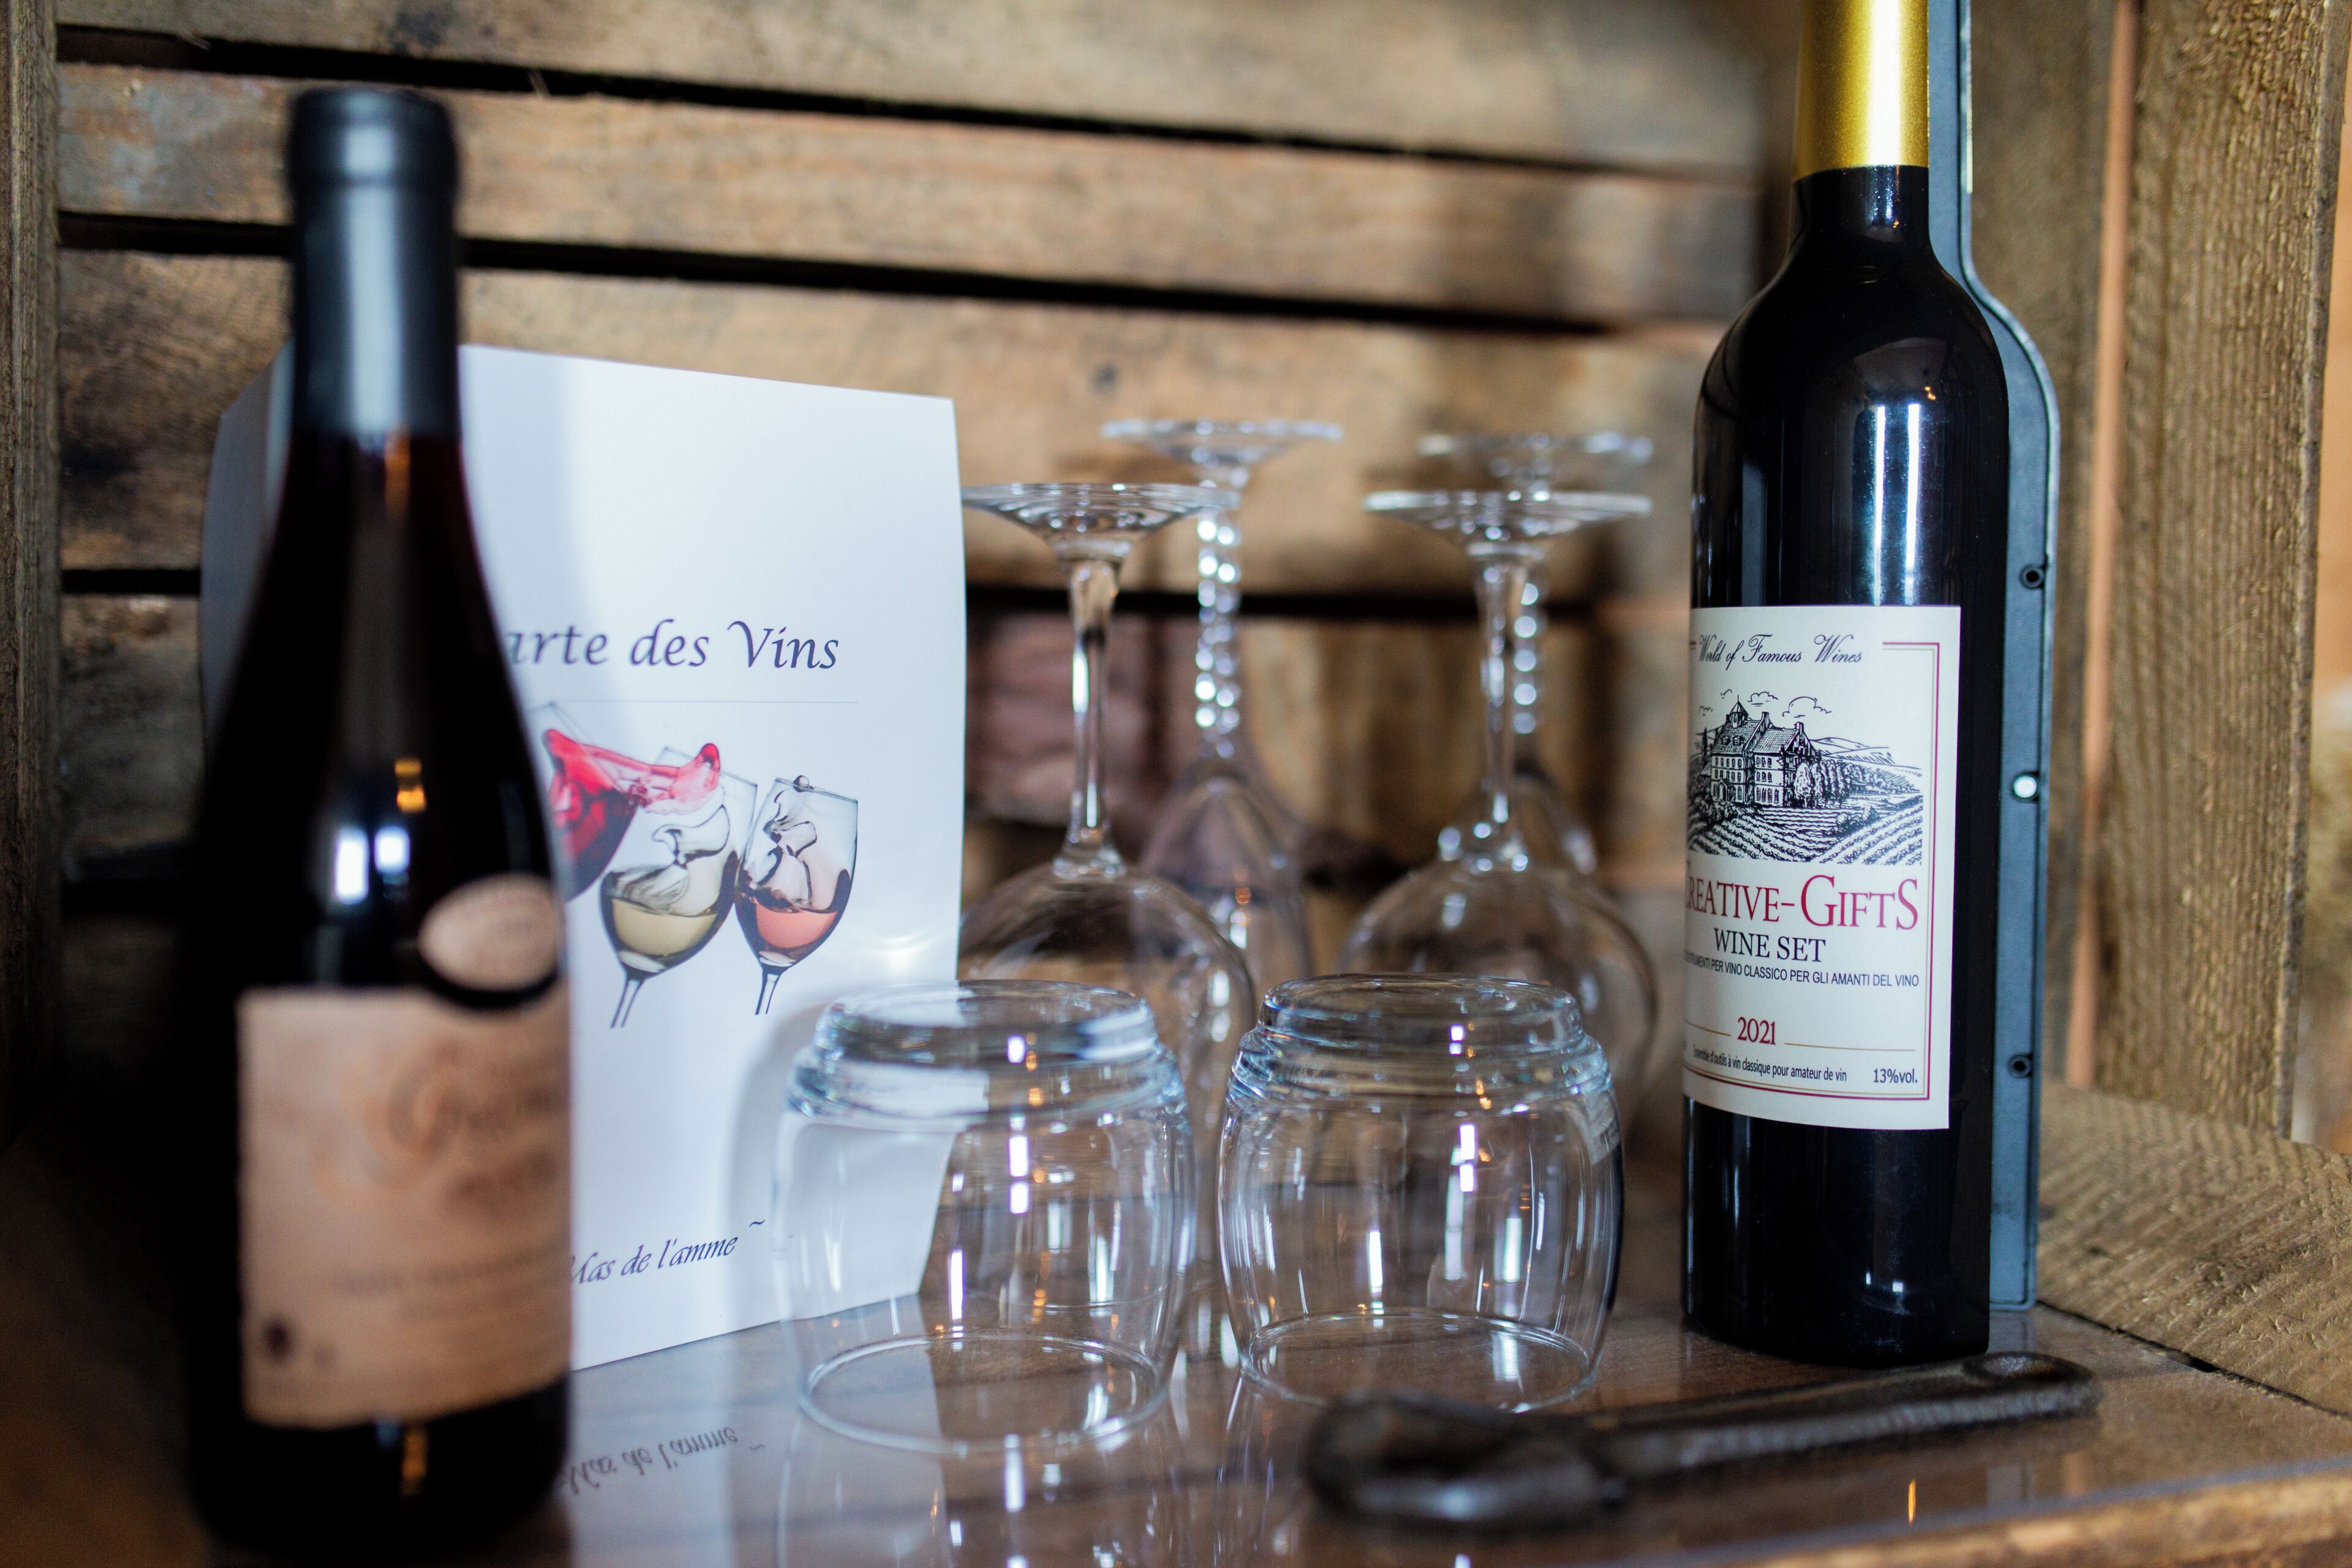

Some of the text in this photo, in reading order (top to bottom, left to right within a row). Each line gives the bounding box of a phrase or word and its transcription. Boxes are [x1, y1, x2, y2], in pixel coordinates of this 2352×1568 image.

[505, 619, 839, 669] arte des Vins
[1699, 634, 1862, 671] World of Famous Wines
[1686, 875, 1918, 930] REATIVE-GIFTS
[1714, 928, 1826, 962] WINE SET
[1711, 959, 1724, 973] PER
[1724, 962, 1742, 975] VINO
[1744, 965, 1787, 981] CLASSICO
[1790, 970, 1810, 982] PER
[1812, 971, 1828, 984] GLI
[1831, 973, 1870, 986] AMANTI
[1873, 974, 1892, 986] DEL
[1895, 975, 1919, 987] VINO
[1737, 1017, 1776, 1045] 2021
[1732, 1056, 1741, 1069] vin
[1742, 1057, 1771, 1077] classique
[1773, 1065, 1789, 1079] pour
[1791, 1066, 1822, 1080] amateur
[1823, 1067, 1834, 1080] de
[1835, 1068, 1847, 1082] vin
[620, 1244, 652, 1276] de
[657, 1236, 739, 1269] l'amme
